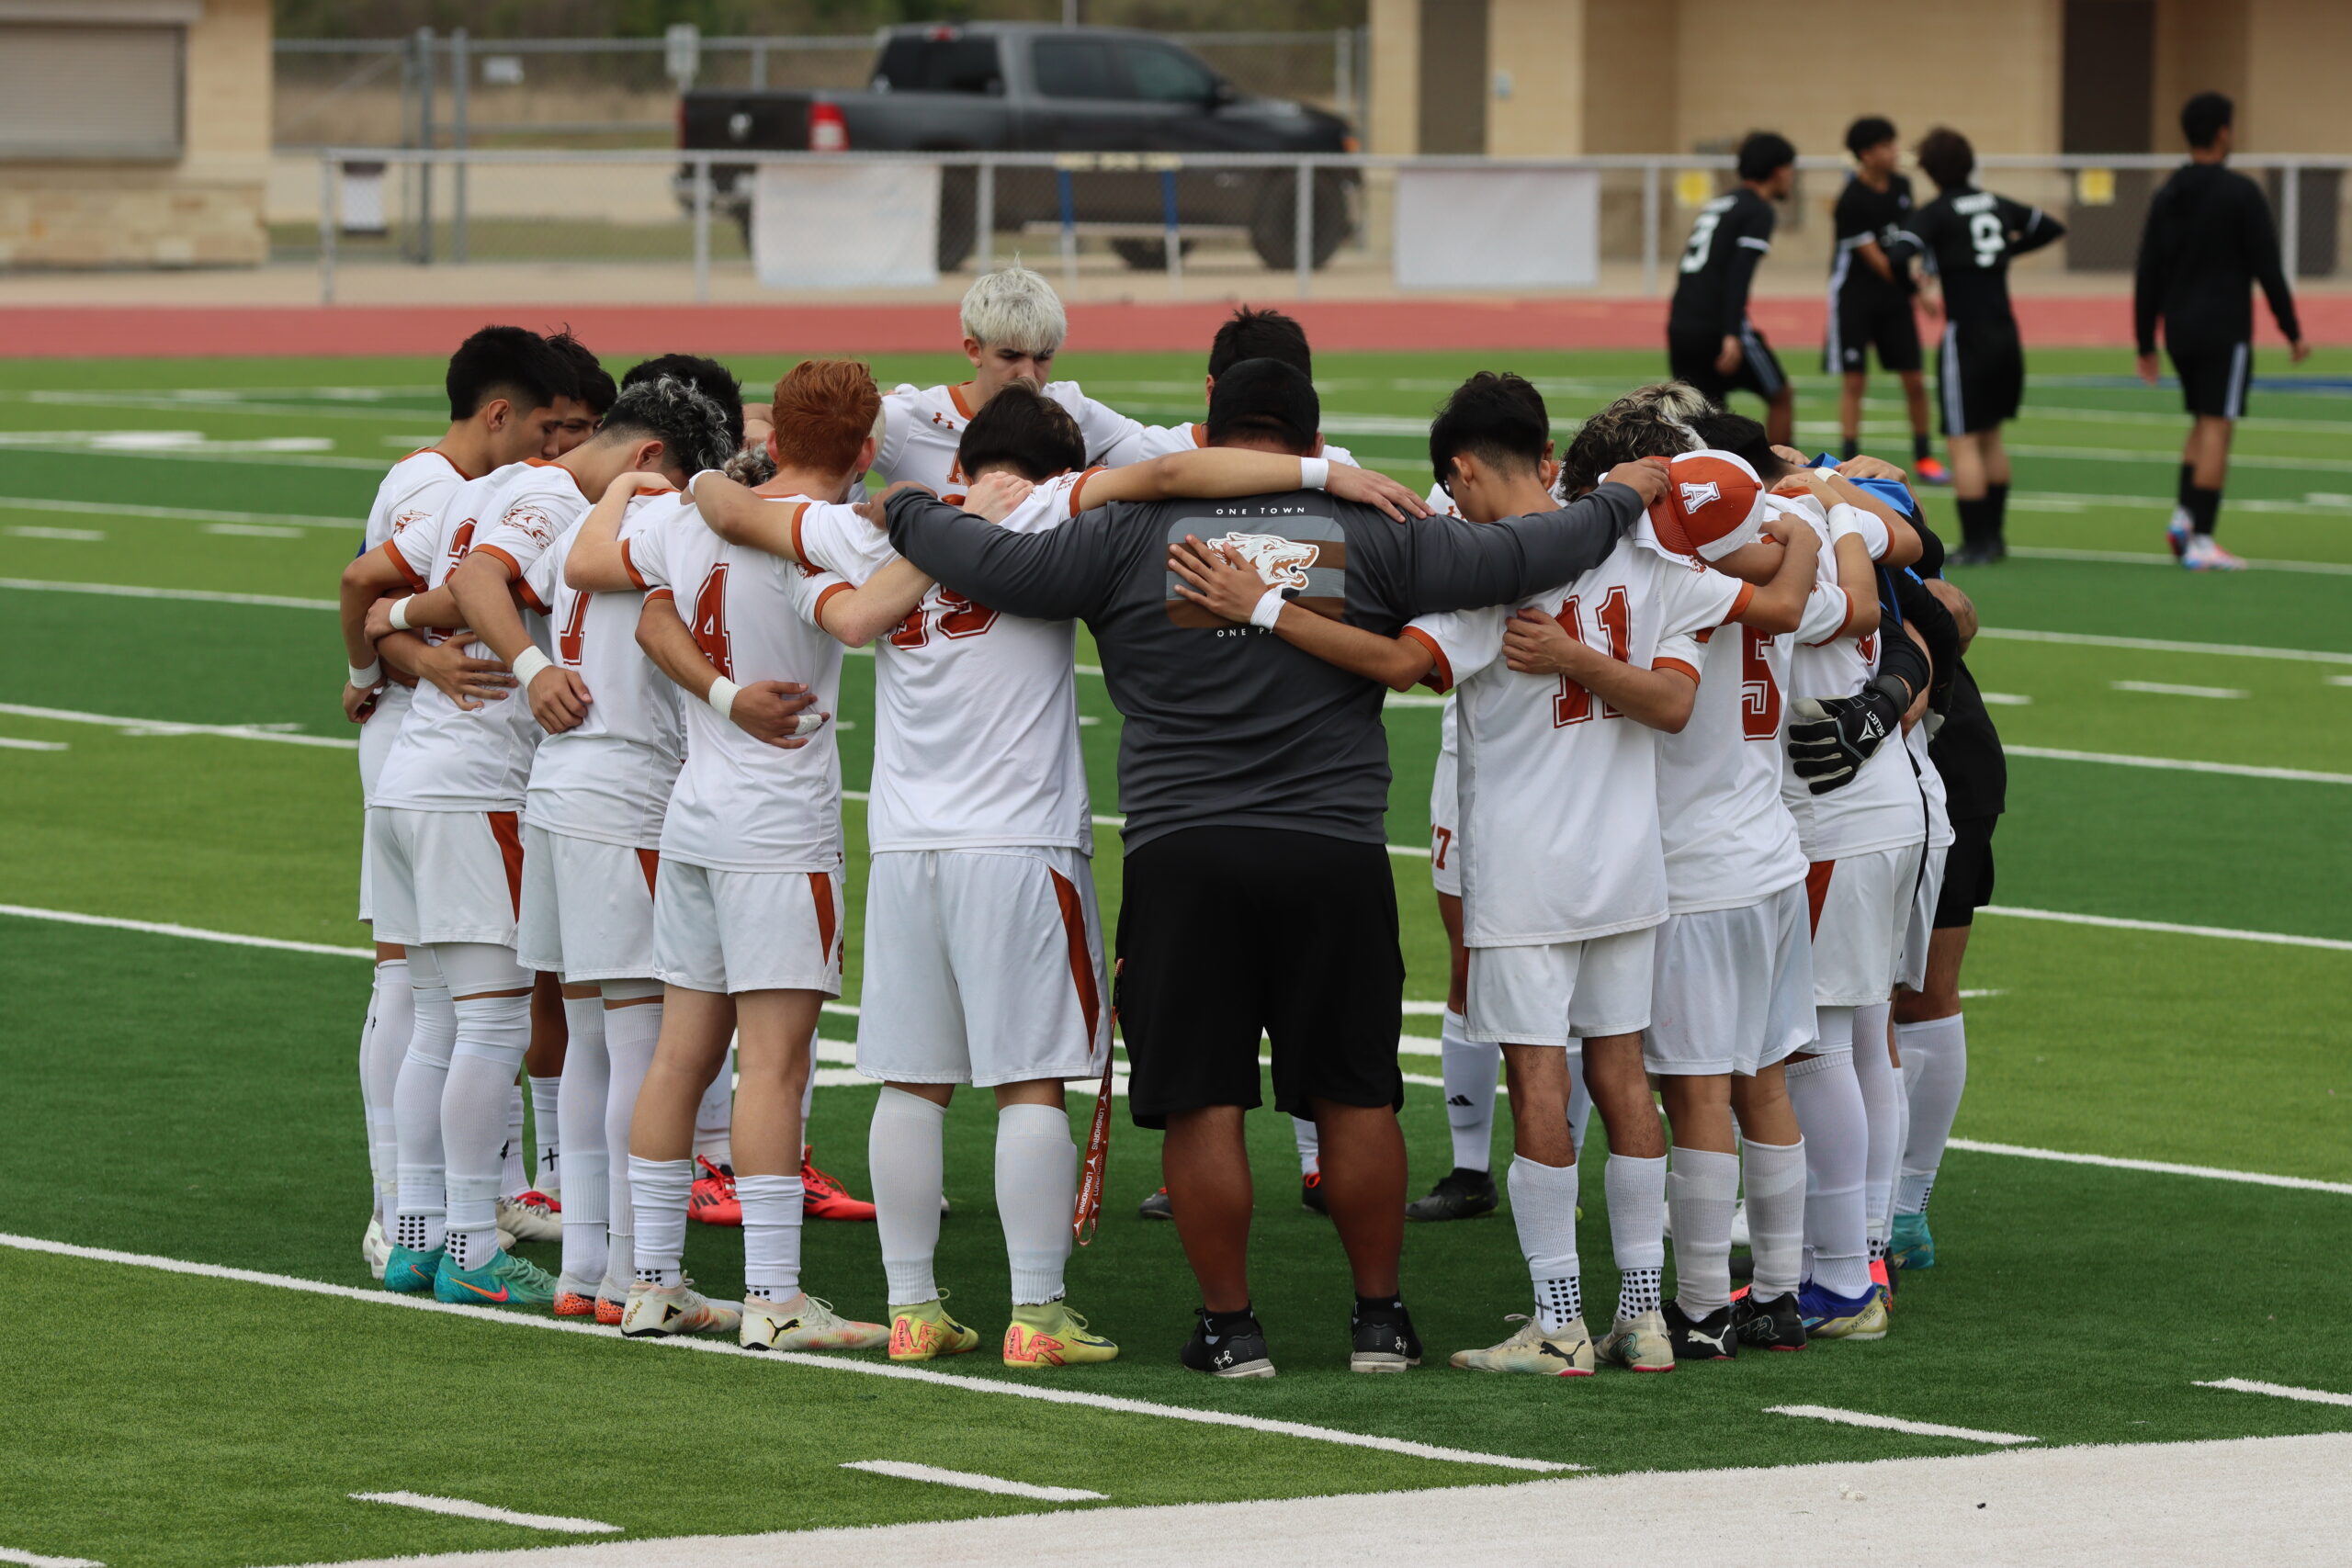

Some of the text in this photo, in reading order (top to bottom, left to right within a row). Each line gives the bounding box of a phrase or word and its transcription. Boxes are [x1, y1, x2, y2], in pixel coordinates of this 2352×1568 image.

[1679, 481, 1721, 514] A
[690, 562, 735, 684] 4
[1216, 628, 1247, 637] ONE
[1552, 584, 1632, 729] 11
[1866, 710, 1886, 738] SELECT
[1091, 1108, 1105, 1151] LONGHORNS
[1078, 1171, 1093, 1214] LONGHORNS
